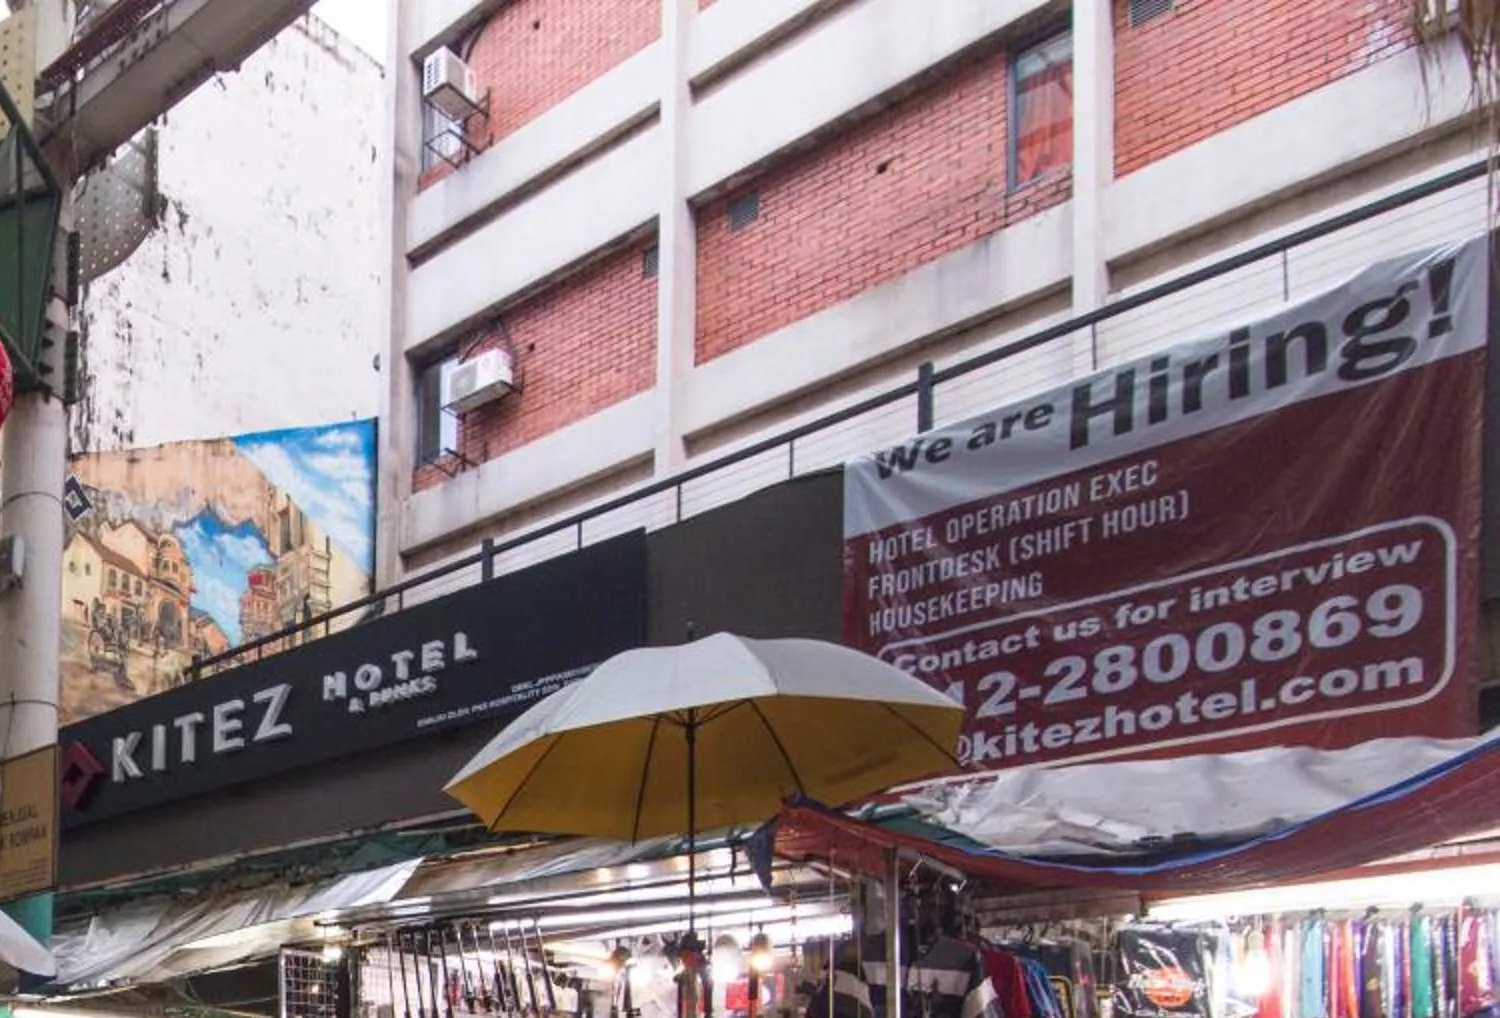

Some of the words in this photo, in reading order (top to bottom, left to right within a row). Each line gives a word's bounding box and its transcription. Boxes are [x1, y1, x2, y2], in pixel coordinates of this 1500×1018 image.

[873, 437, 954, 481] We
[965, 402, 1056, 451] are
[1069, 257, 1456, 451] Hiring!
[867, 544, 1001, 601] FRONTDESK
[1009, 518, 1094, 566] (SHIFT
[1102, 489, 1190, 539] HOUR)
[868, 526, 938, 566] HOTEL
[946, 482, 1081, 545] OPERATION
[1089, 459, 1159, 502] EXEC
[868, 571, 1044, 638] HOUSEKEEPING
[891, 625, 1042, 676] Contact
[1053, 616, 1102, 642] us
[1114, 599, 1177, 630] for
[1189, 540, 1424, 613] interview
[111, 682, 294, 784] KITEZ
[322, 631, 479, 701] HOTEL
